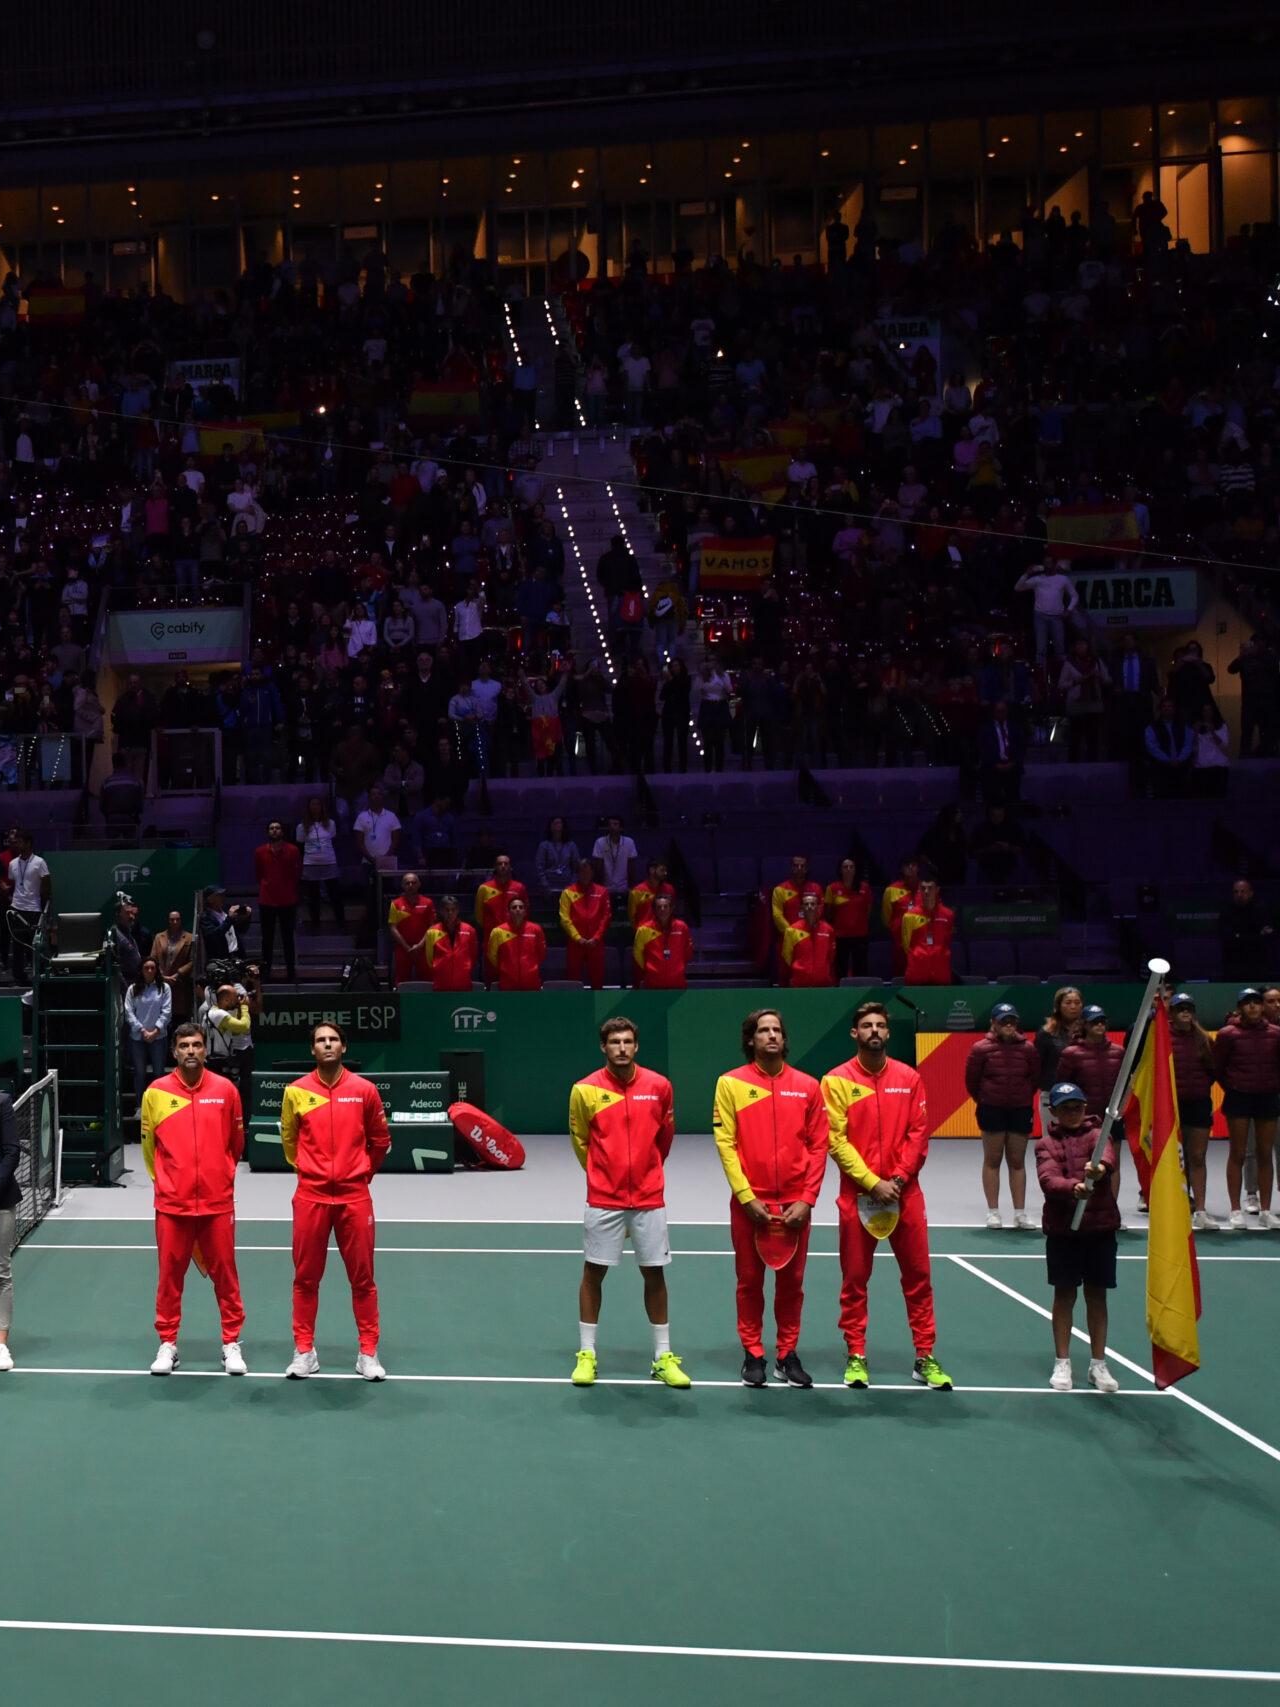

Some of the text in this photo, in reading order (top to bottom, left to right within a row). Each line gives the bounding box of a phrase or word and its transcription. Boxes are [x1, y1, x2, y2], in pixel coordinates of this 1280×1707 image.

[705, 557, 769, 570] VAMOS
[167, 622, 205, 635] cabify
[358, 1006, 397, 1030] ESP
[409, 1080, 442, 1090] Adecco
[260, 1098, 282, 1108] Adec
[410, 1099, 443, 1109] Adecco
